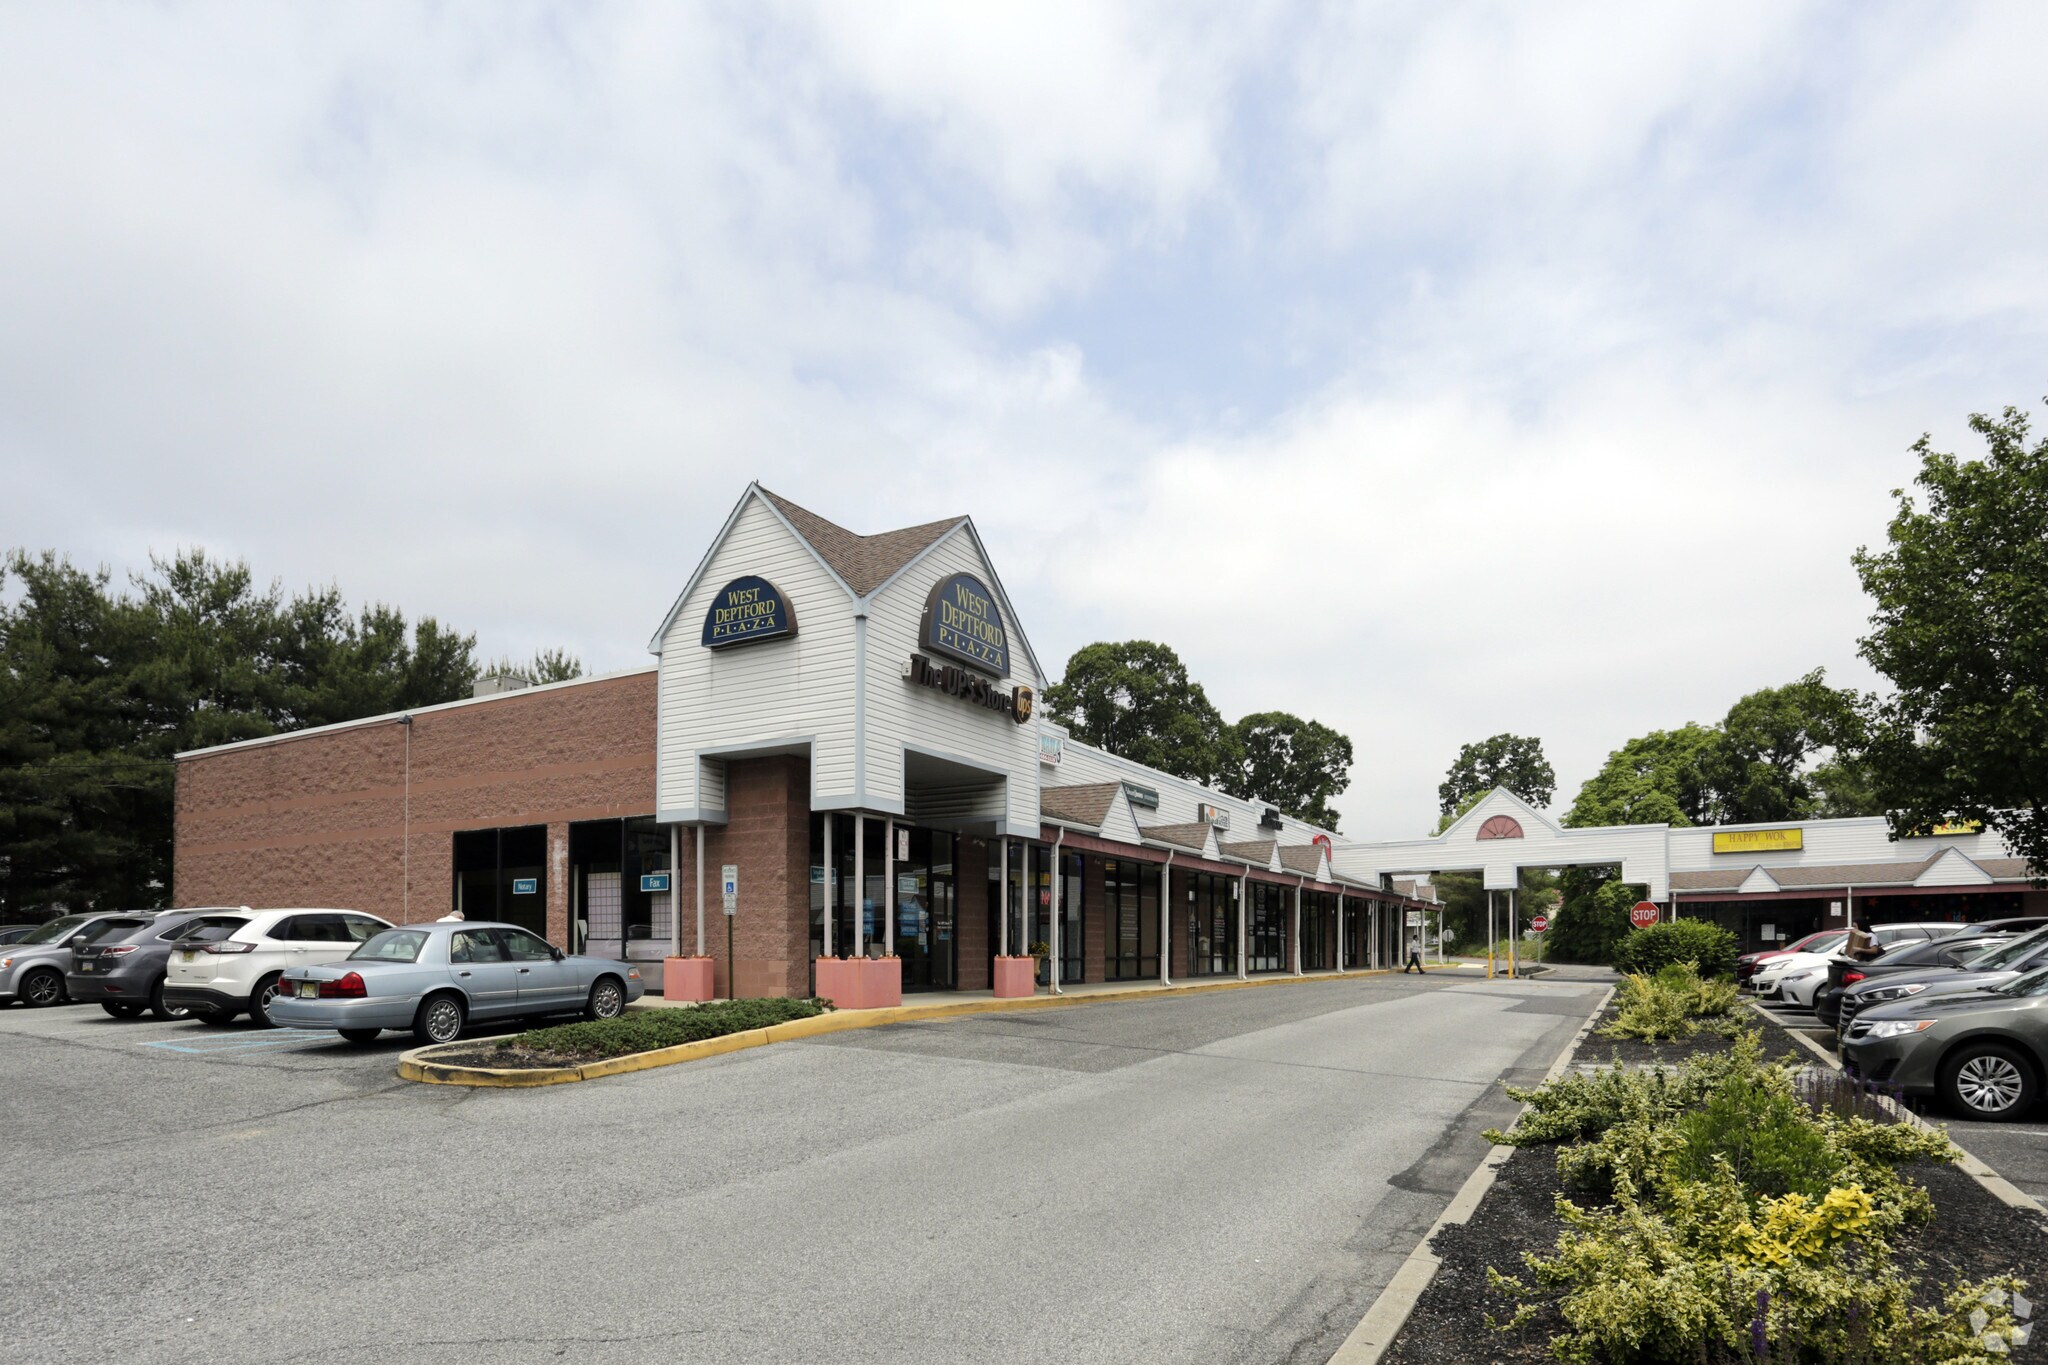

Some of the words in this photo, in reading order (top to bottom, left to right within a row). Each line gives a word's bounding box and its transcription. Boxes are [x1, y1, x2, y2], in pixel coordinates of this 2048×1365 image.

[728, 587, 760, 607] WEST
[956, 583, 990, 620] WEST
[715, 599, 776, 625] DEPTFORD
[942, 600, 1003, 648] DEPTFORD
[911, 653, 943, 689] The
[943, 665, 976, 701] UPS
[976, 678, 1012, 713] Store
[1018, 699, 1032, 718] ups
[1729, 832, 1760, 843] HAPPY
[1765, 831, 1787, 841] WOK
[649, 878, 661, 888] Fax
[1633, 909, 1657, 921] STOP
[1532, 921, 1547, 929] STOP
